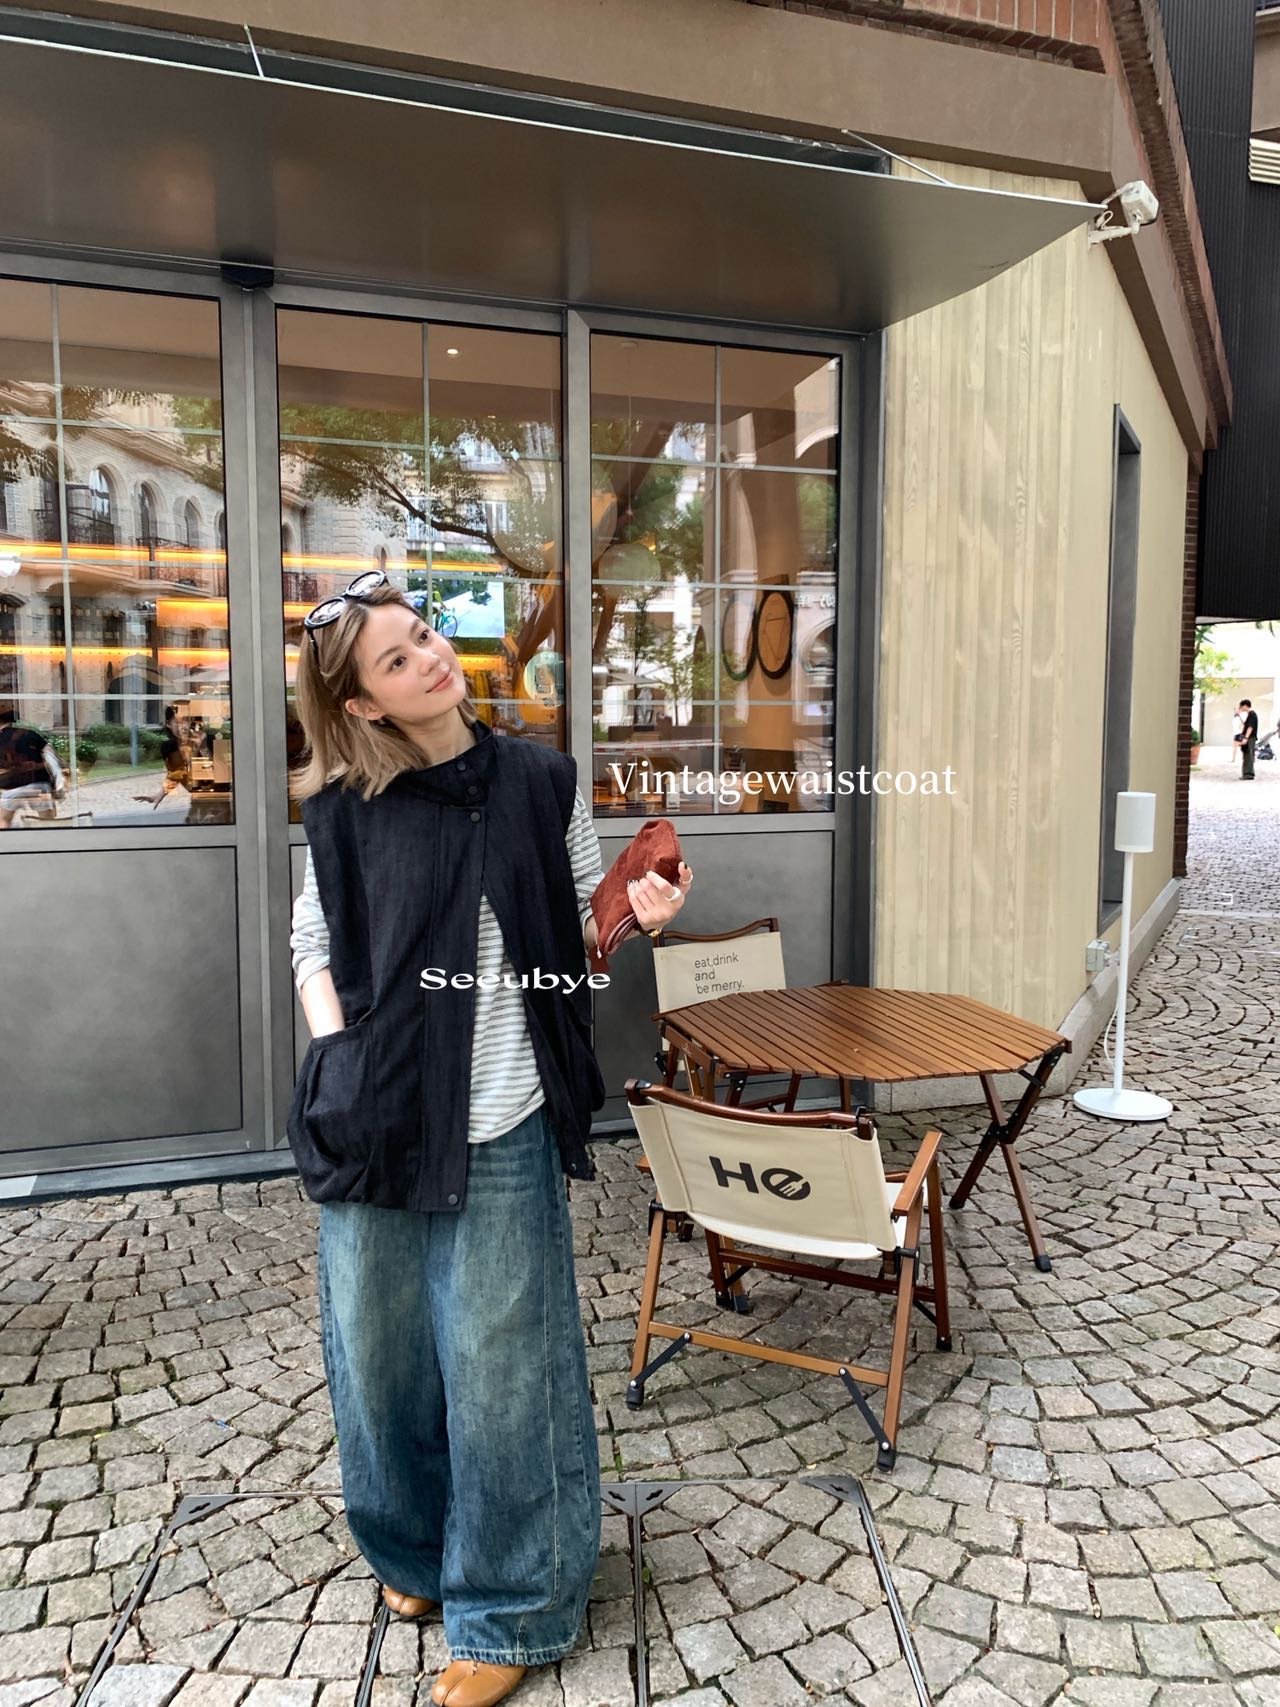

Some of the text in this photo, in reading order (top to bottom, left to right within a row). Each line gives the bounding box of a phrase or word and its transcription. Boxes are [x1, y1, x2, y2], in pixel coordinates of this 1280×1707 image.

[694, 969, 716, 982] and
[696, 979, 745, 995] be merry.
